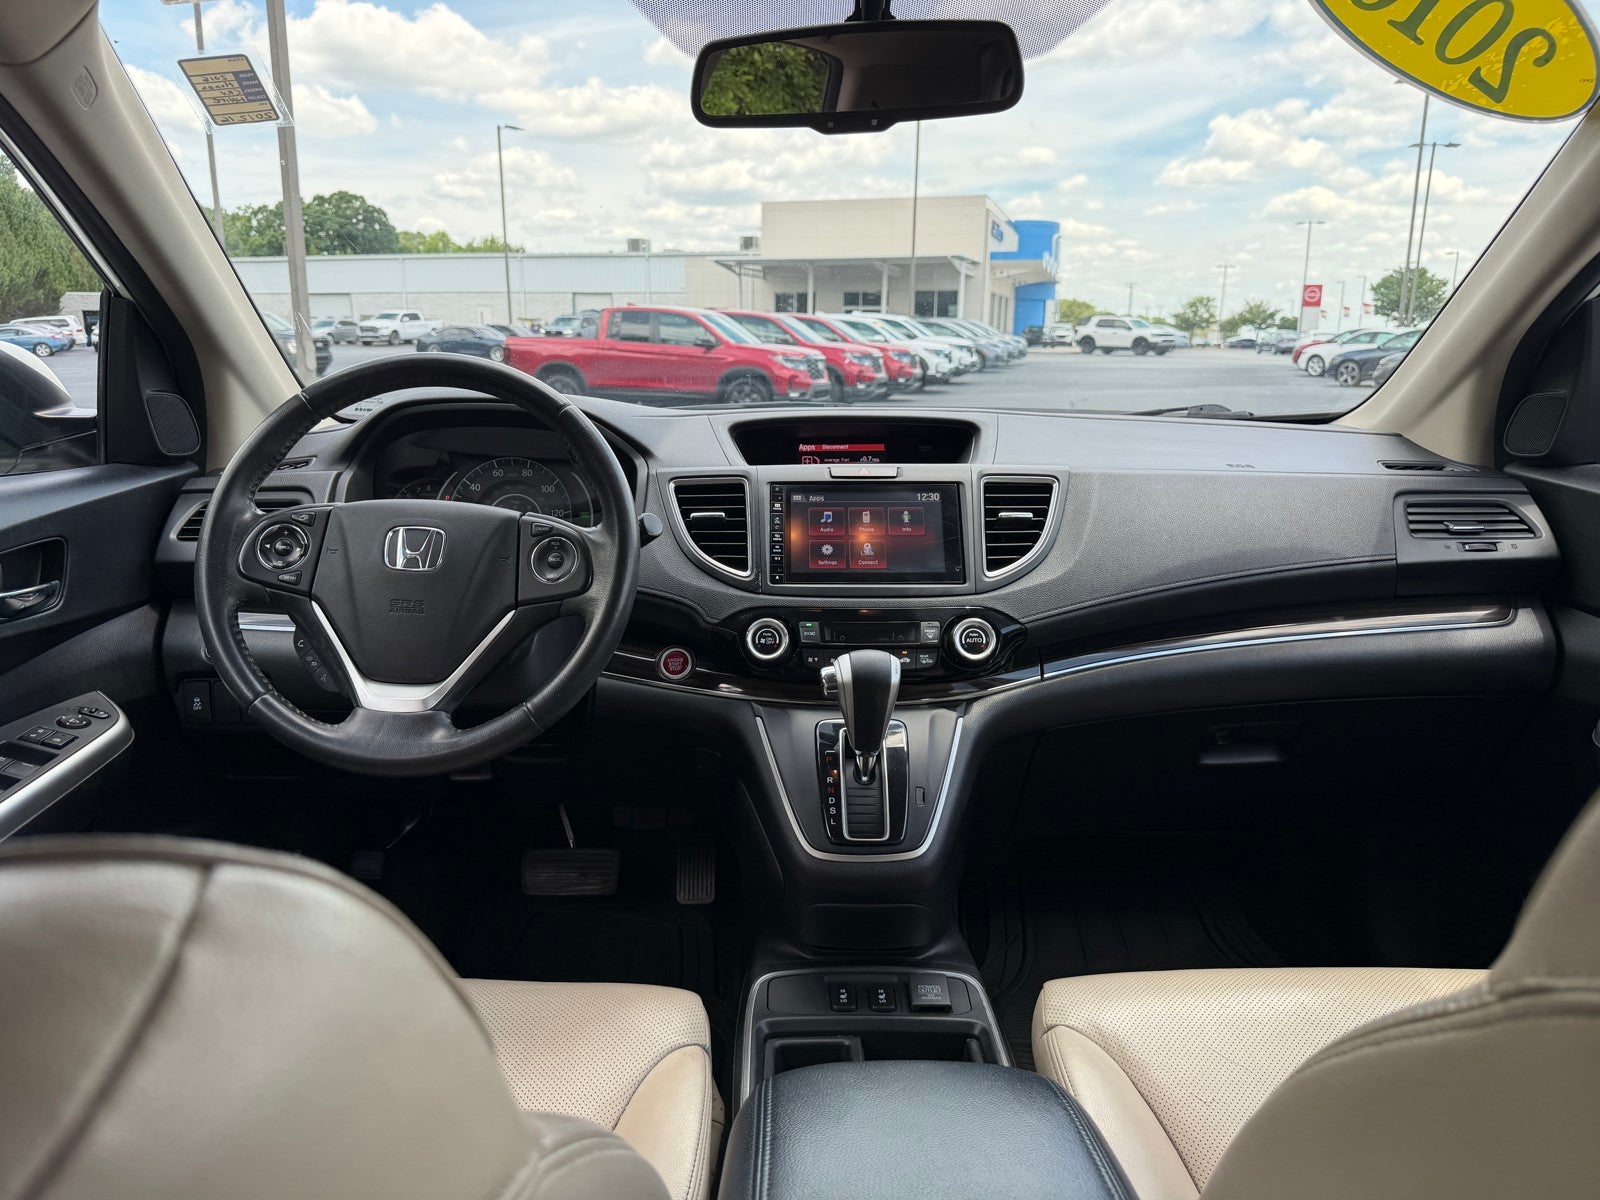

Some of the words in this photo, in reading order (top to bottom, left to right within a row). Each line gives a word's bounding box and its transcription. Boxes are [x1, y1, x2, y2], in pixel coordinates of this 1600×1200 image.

[469, 483, 481, 491] 40
[541, 485, 555, 493] 100
[917, 493, 940, 501] 12:30
[551, 509, 564, 517] 120
